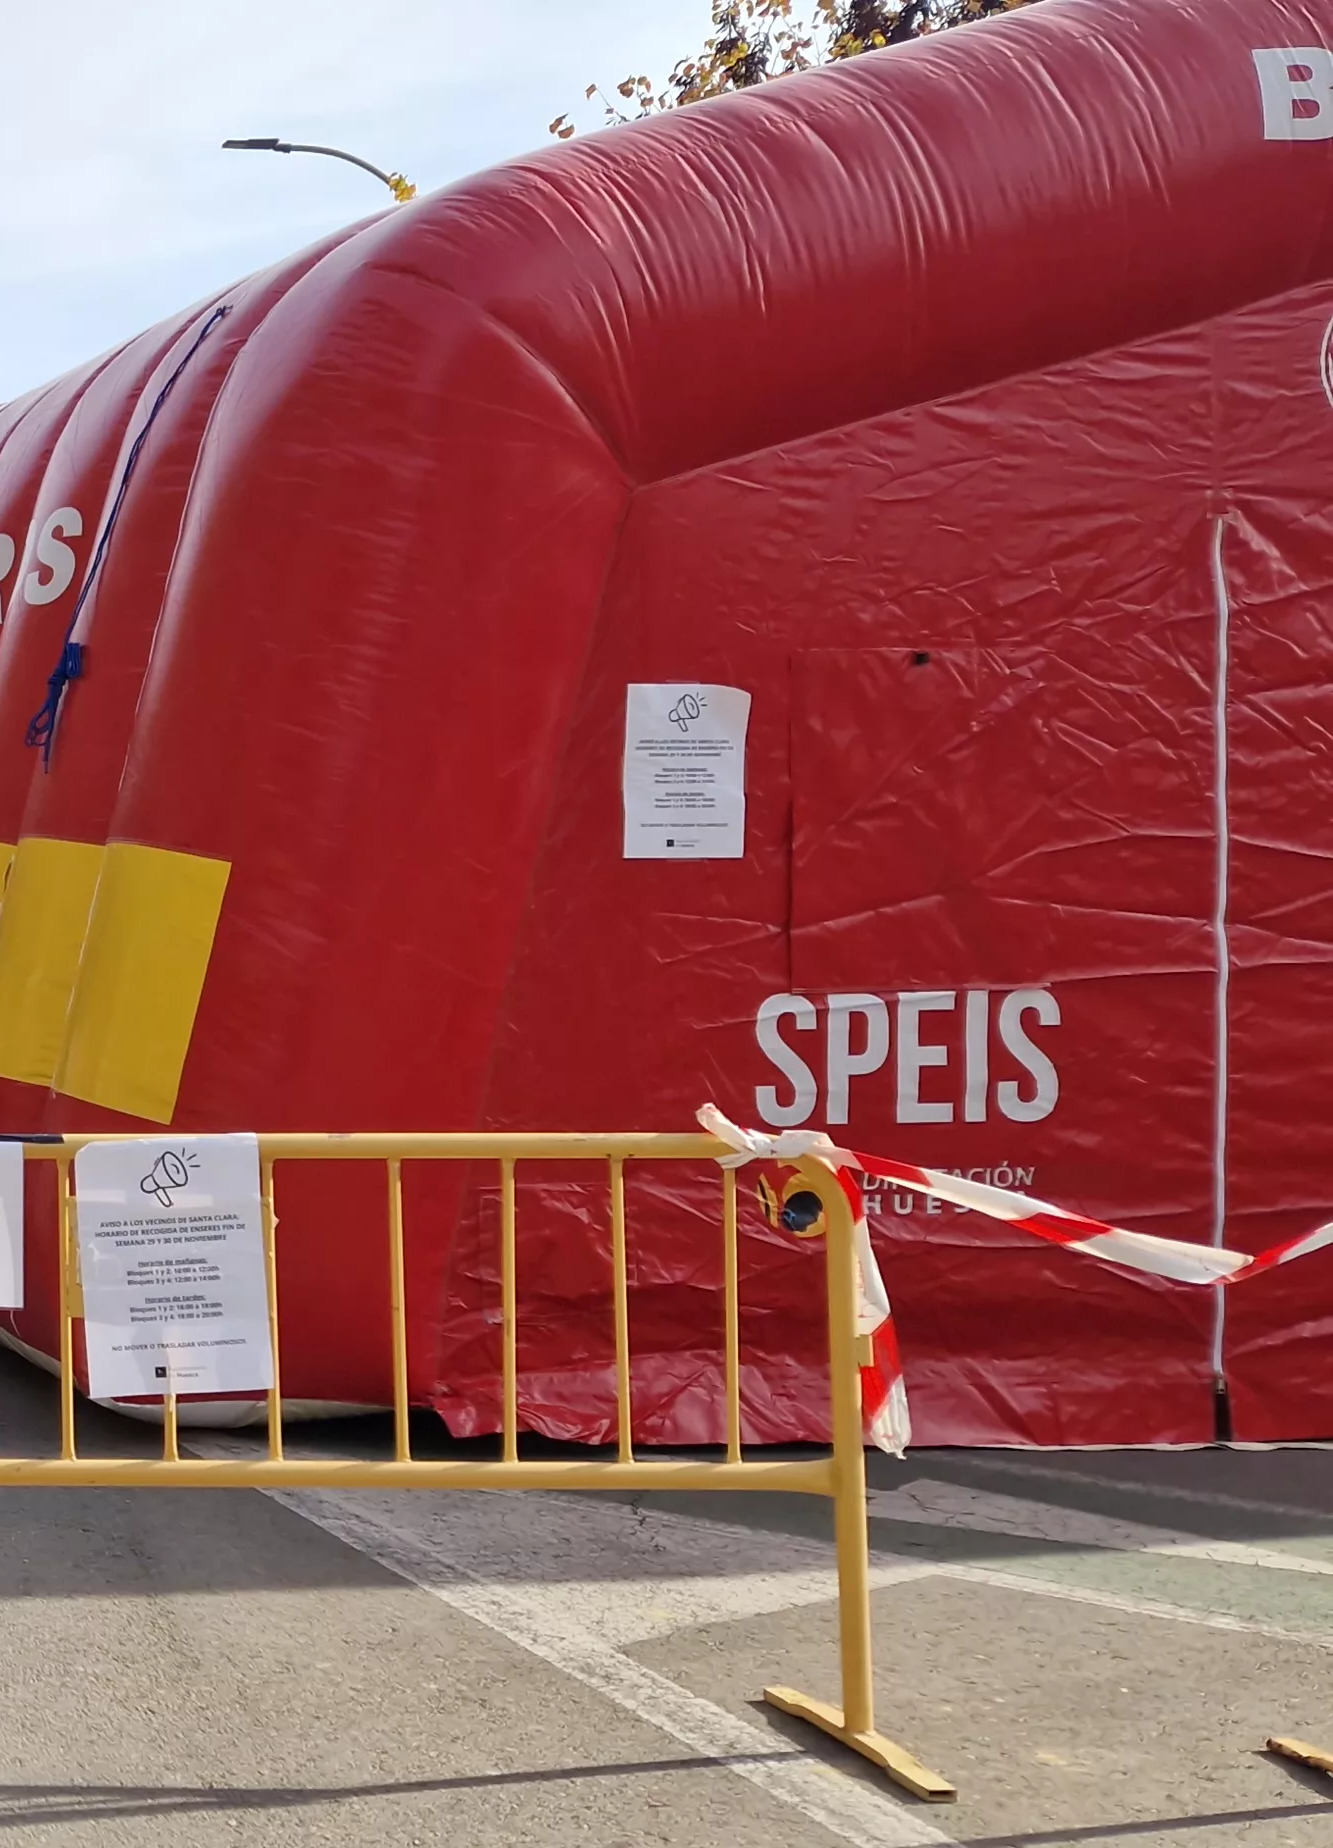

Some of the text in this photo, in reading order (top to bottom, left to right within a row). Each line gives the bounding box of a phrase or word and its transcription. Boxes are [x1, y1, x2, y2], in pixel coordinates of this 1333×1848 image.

[755, 989, 1061, 1127] SPEIS
[144, 1218, 176, 1226] VECINOS
[157, 1341, 195, 1349] TRASLADAR
